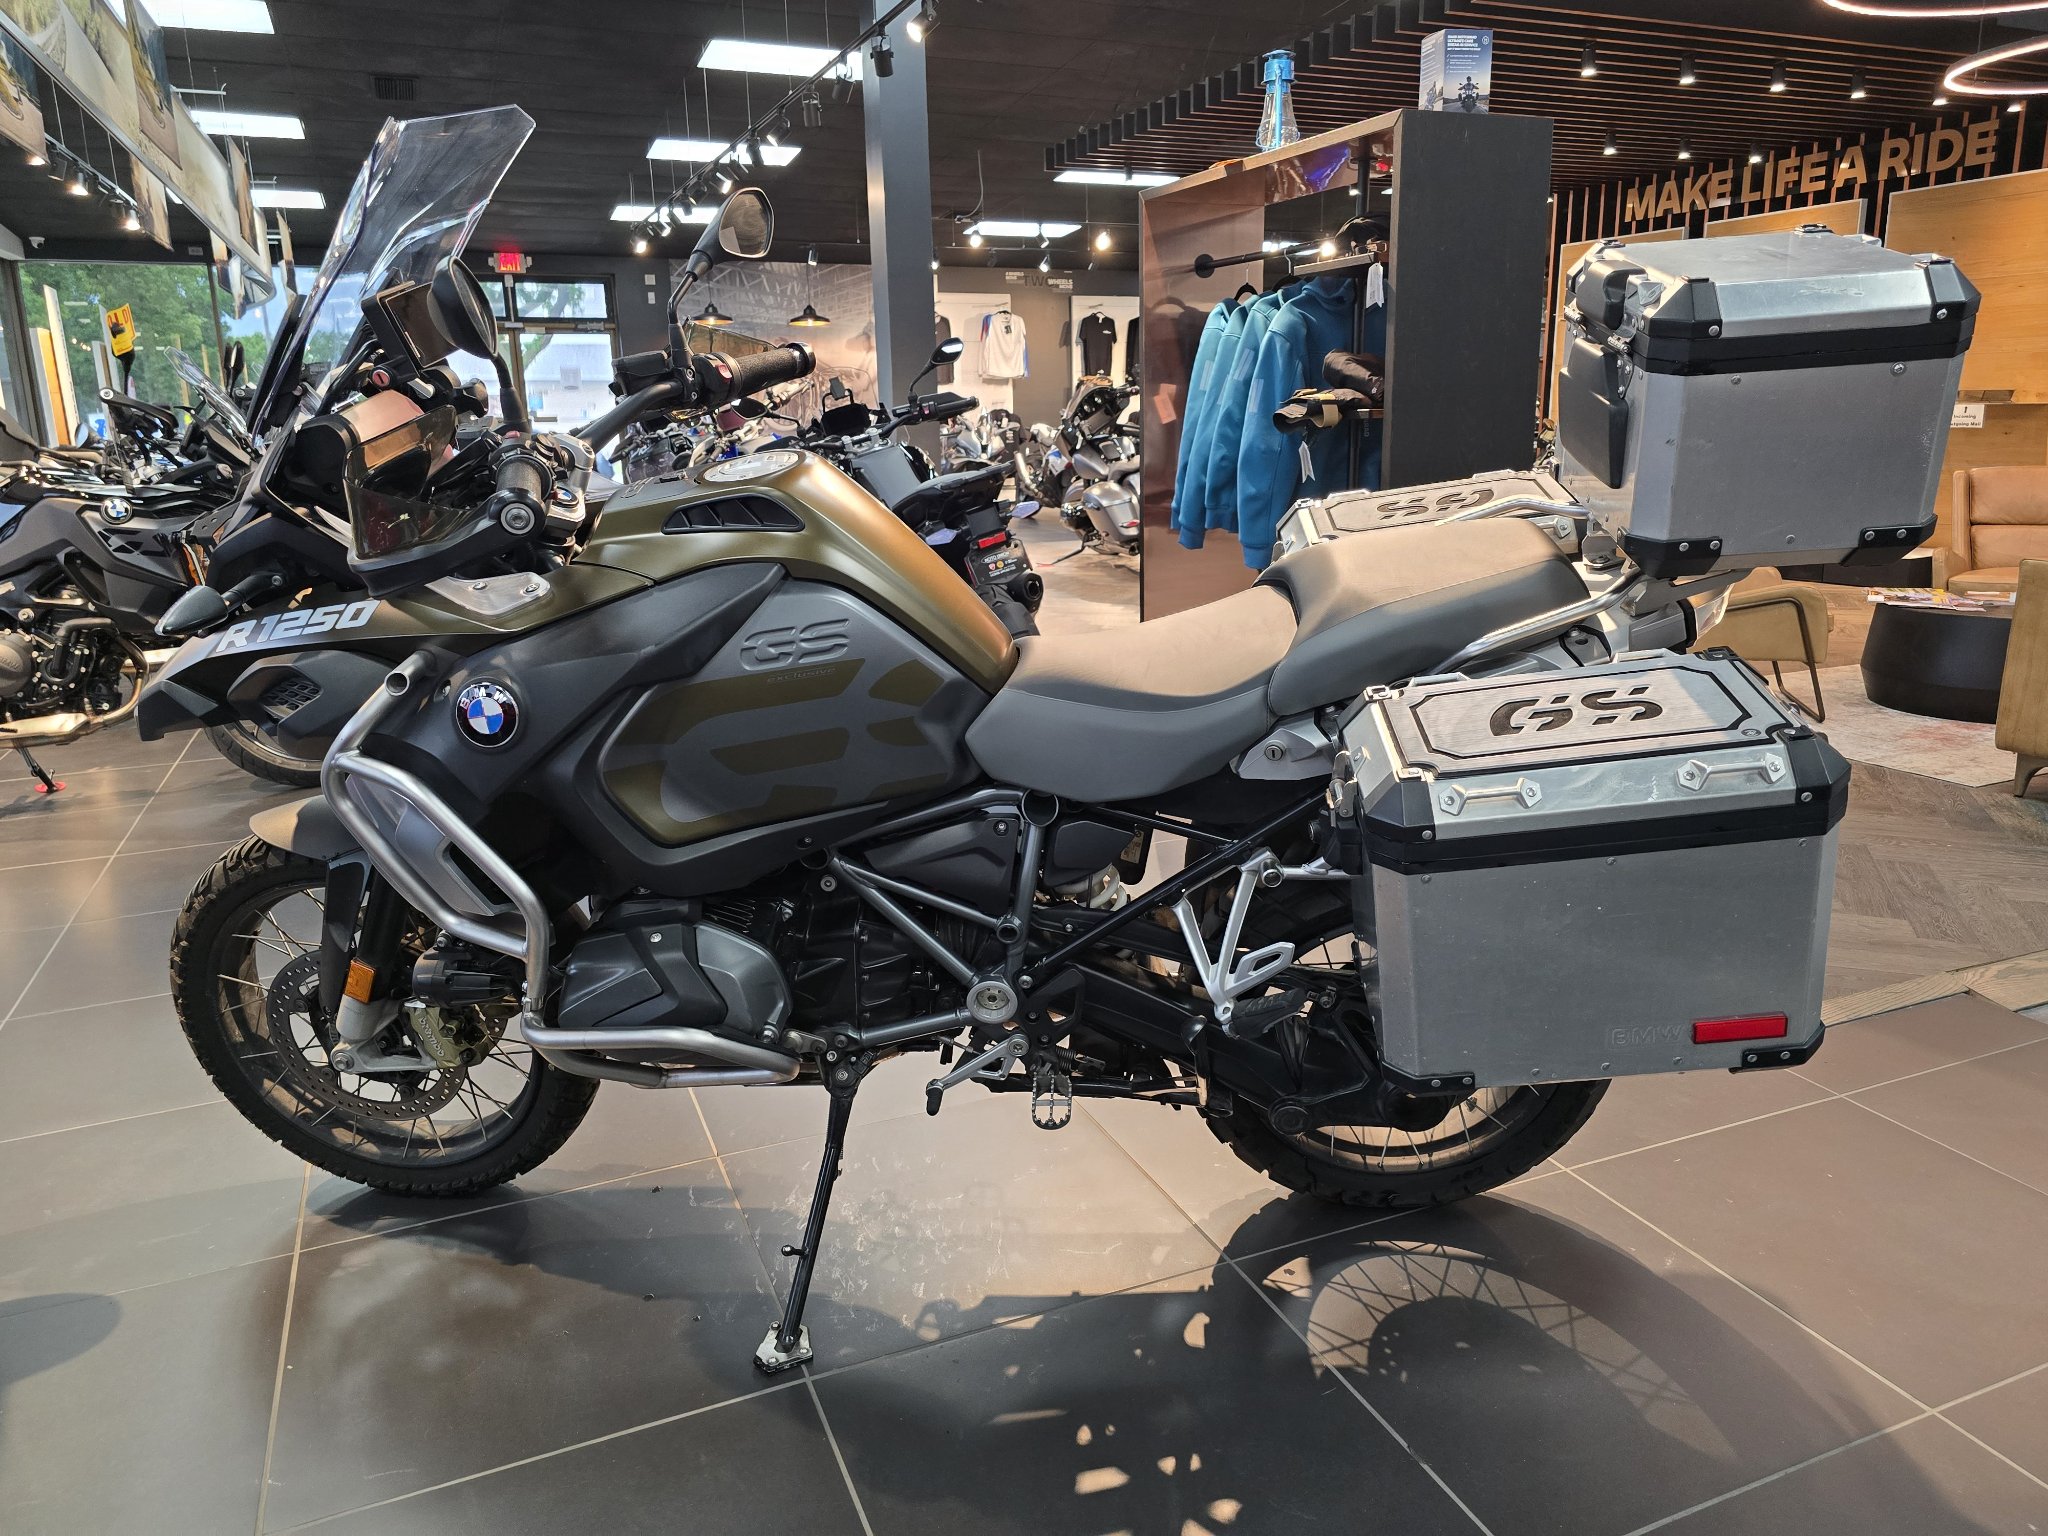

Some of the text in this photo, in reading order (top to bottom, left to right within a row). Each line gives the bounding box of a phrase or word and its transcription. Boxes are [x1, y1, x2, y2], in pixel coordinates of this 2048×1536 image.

[1624, 119, 2000, 222] MAKE LIFE A RIDE
[499, 254, 521, 271] EXIT
[215, 600, 381, 653] R 1250
[740, 618, 850, 671] GS
[460, 686, 508, 710] BMW
[1489, 686, 1664, 737] GS
[1611, 1024, 1684, 1046] BMW
